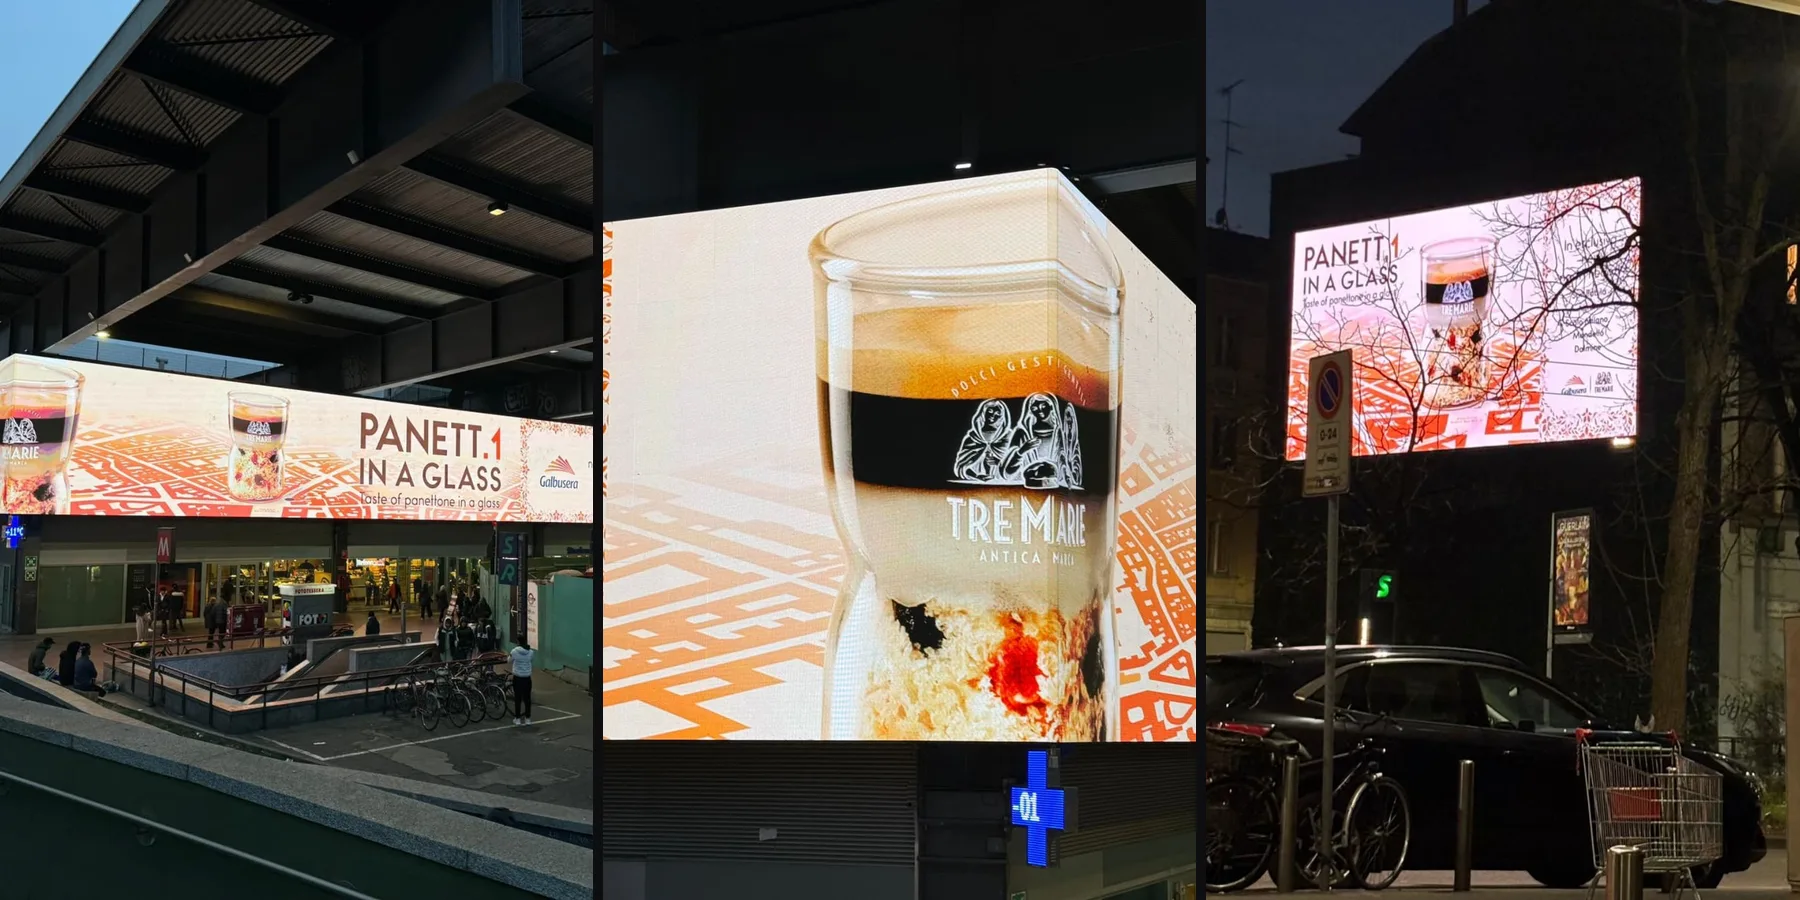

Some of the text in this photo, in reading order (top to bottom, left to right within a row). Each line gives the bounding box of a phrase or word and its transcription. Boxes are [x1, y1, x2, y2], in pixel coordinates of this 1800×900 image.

[1303, 264, 1398, 295] IN A GLASS
[951, 367, 996, 398] DOLCI
[1007, 356, 1061, 372] GESTI
[360, 411, 502, 461] PANETT.1
[360, 457, 502, 492] IN A GLASS
[540, 475, 579, 489] Galbusera
[361, 491, 501, 512] Taste of panettone in a glass
[158, 537, 169, 556] M
[502, 536, 514, 554] S
[980, 549, 1041, 565] ANTICA
[501, 563, 515, 581] R
[1376, 575, 1393, 599] S
[1012, 791, 1041, 822] -01
